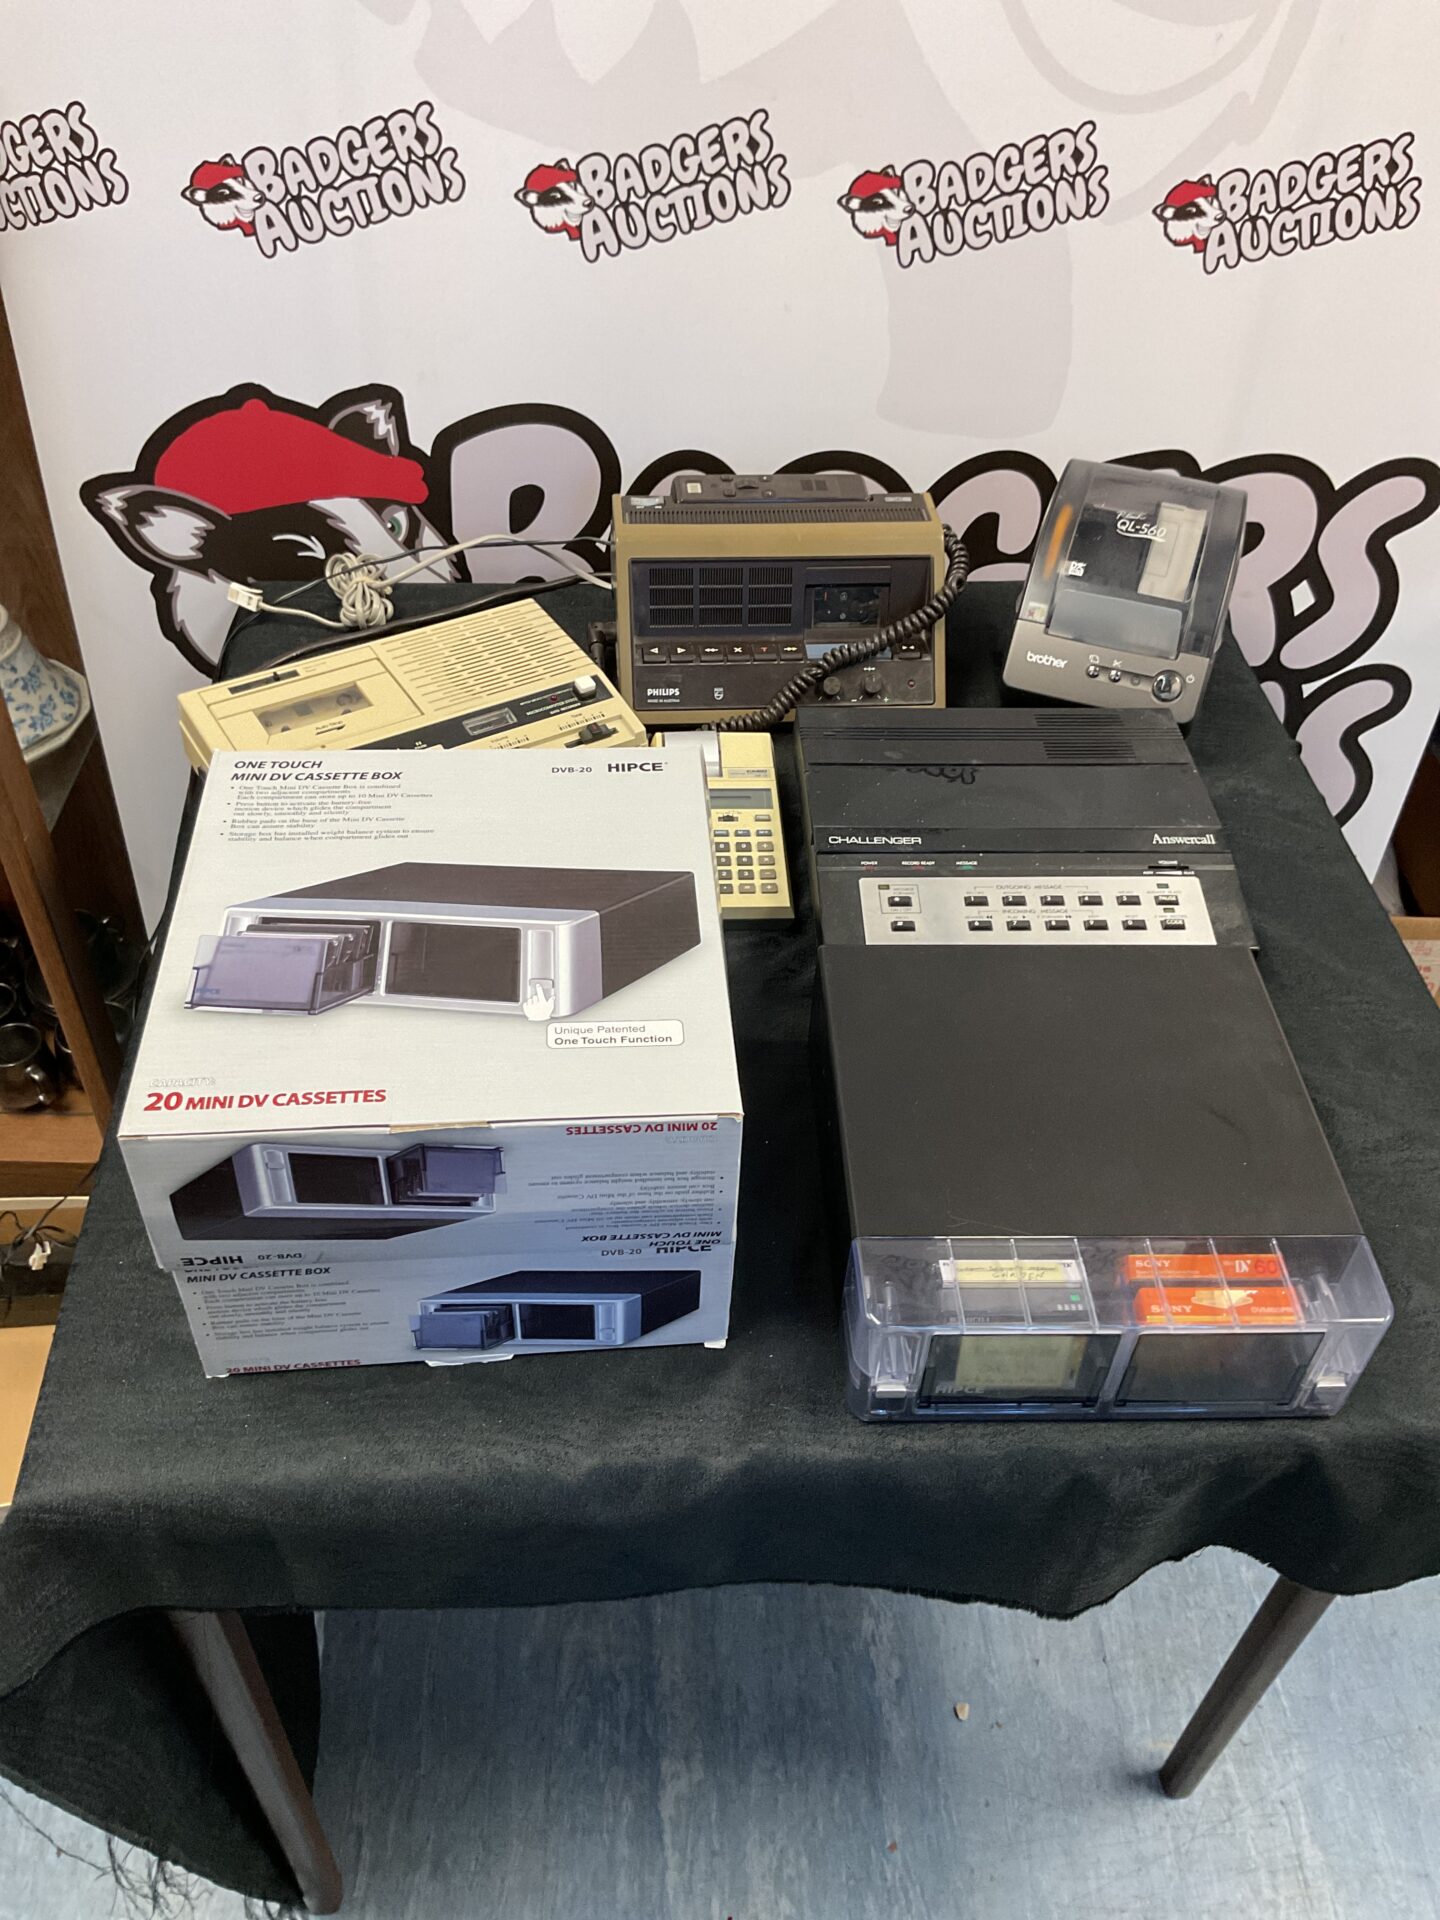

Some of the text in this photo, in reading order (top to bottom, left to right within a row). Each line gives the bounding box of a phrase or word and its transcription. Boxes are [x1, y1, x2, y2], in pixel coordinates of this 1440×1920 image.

[243, 101, 442, 201] BADGERS
[577, 108, 775, 208] BADGERS
[901, 120, 1097, 215] BADGERS
[1214, 132, 1416, 223] BADGERS
[254, 147, 467, 258] AUCTIONS
[580, 152, 791, 263] AUCTIONS
[895, 166, 1110, 268] AUCTIONS
[1202, 177, 1423, 275] AUCTIONS
[1116, 519, 1167, 537] QL-560
[1026, 651, 1068, 668] brother
[647, 688, 680, 696] PHILIPS
[234, 760, 323, 769] ONE TOUCH
[607, 762, 664, 772] HIPCE
[230, 772, 403, 781] MINI DV CASSETTE BOX
[828, 835, 922, 845] CHALLENGER
[1151, 833, 1216, 846] Answercall
[554, 1025, 646, 1035] Unique Patented
[581, 1036, 617, 1044] Touch
[620, 1035, 672, 1043] Function
[143, 1089, 387, 1111] 20 MINI DV CASSETTES
[565, 1122, 718, 1135] 20 MINI DV CASSETTES
[607, 1232, 671, 1240] CASSETTE
[672, 1231, 691, 1239] DV
[180, 1256, 243, 1266] HIPCE
[1254, 1259, 1278, 1274] 60
[186, 1275, 216, 1283] MINI
[219, 1273, 237, 1281] DV
[240, 1269, 302, 1279] CASSETTE
[305, 1267, 331, 1276] BOX
[294, 1359, 361, 1369] CASSETTES
[935, 1386, 985, 1394] HIPCE
